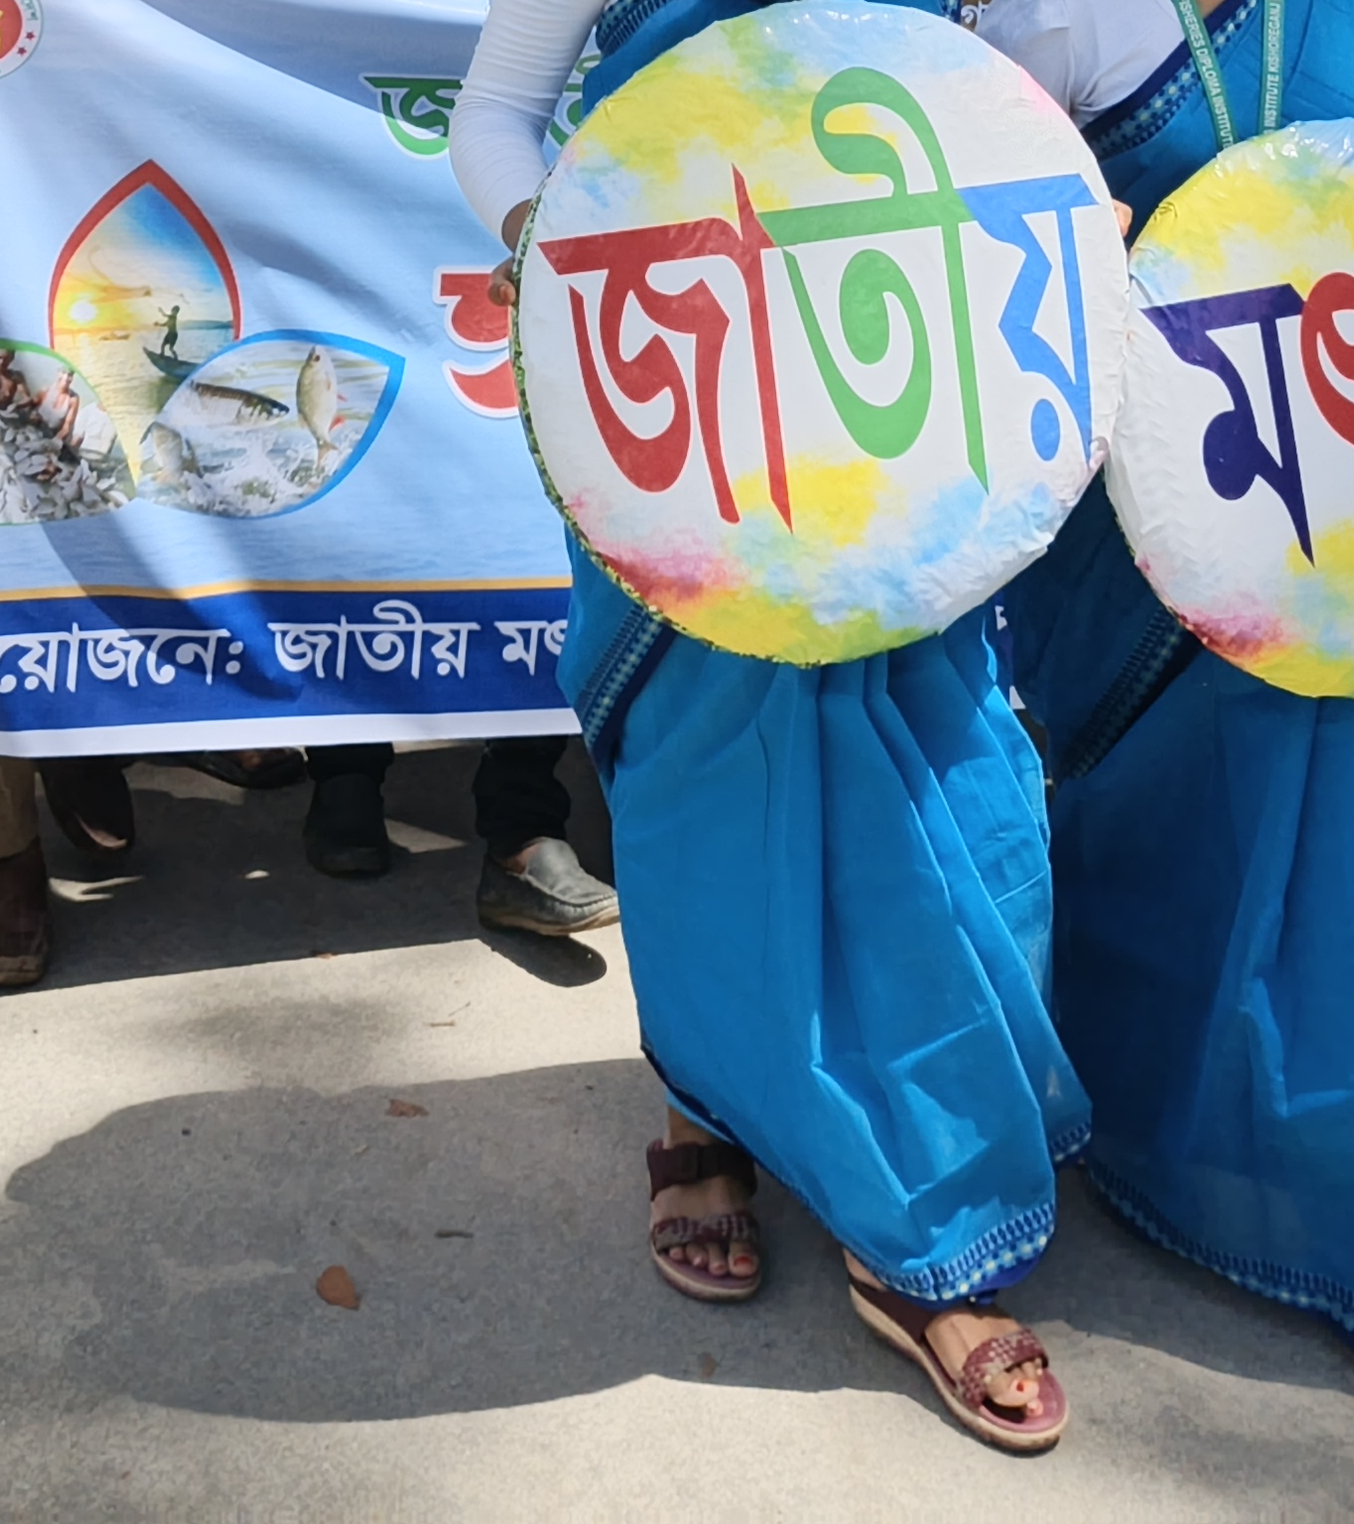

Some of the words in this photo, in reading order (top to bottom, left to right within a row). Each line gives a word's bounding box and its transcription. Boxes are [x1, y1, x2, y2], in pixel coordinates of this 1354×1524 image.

[1195, 46, 1222, 98] DIPLOMA
[1266, 3, 1281, 73] KISHOREGANJ
[1264, 73, 1280, 128] INSTITUTE
[537, 66, 1099, 536] জাতীয়
[267, 599, 480, 681] জাতীয়
